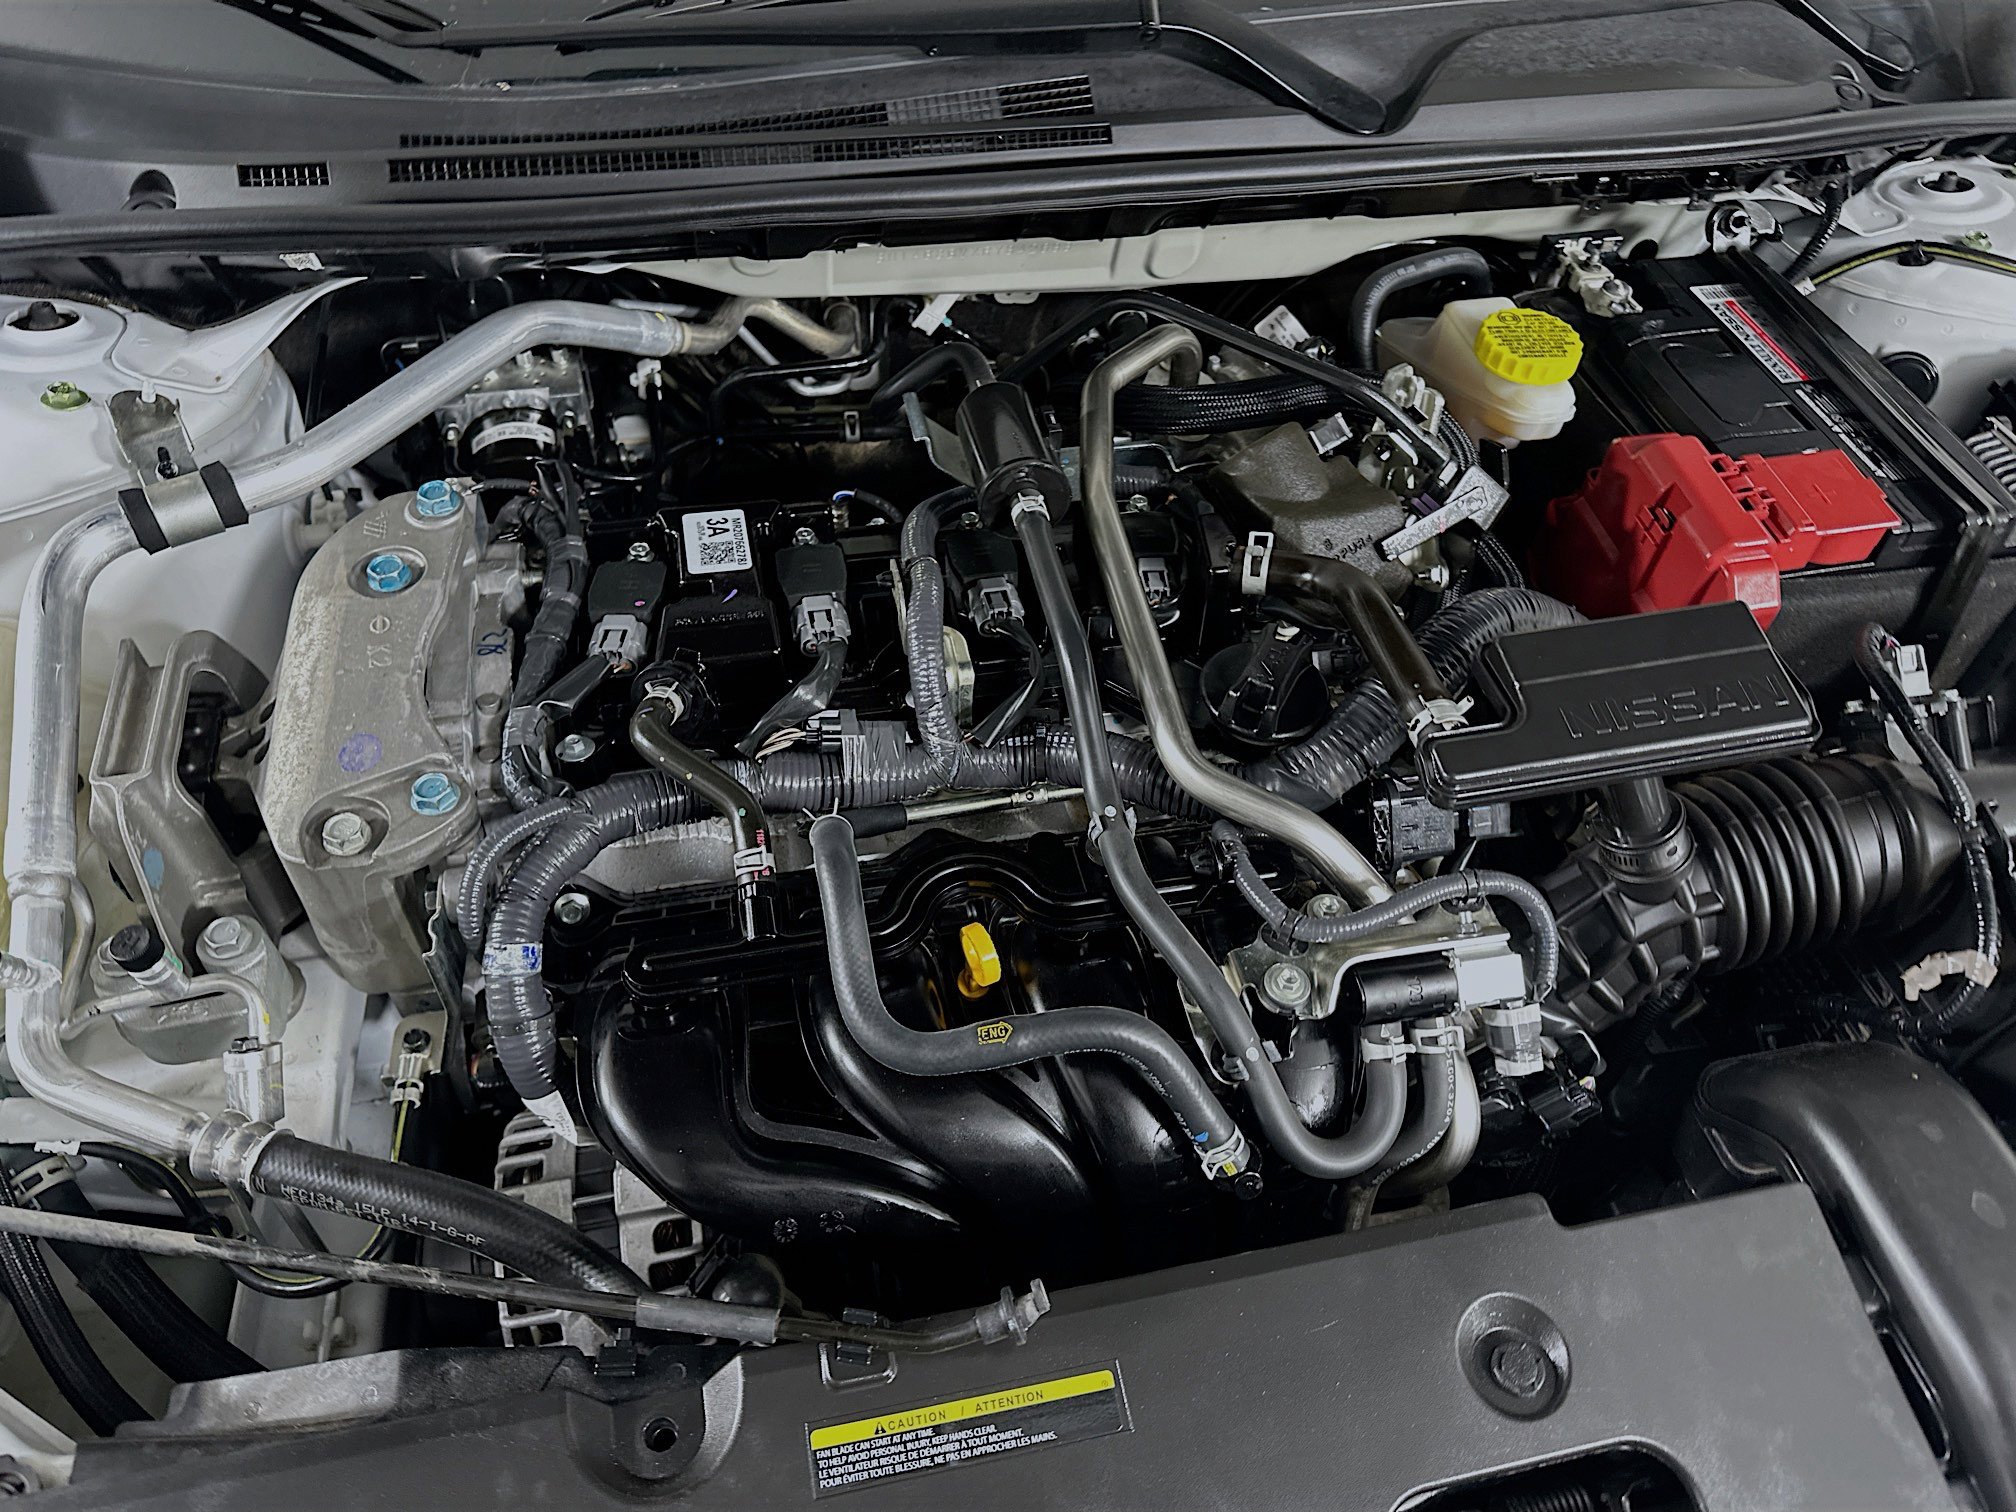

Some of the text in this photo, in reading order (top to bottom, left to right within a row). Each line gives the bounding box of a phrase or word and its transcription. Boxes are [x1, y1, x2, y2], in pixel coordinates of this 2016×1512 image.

[706, 517, 730, 538] 3A
[1558, 673, 1790, 739] NISSAN
[981, 1025, 1006, 1040] ENG
[887, 1410, 947, 1431] CAUTION
[975, 1389, 1044, 1413] ATTENTION
[816, 1449, 831, 1460] FAN
[831, 1445, 855, 1457] BLADE
[854, 1442, 870, 1453] CAN
[870, 1437, 893, 1449] START
[892, 1434, 901, 1443] AT
[818, 1459, 829, 1469] TO
[829, 1455, 847, 1467] HELP
[847, 1451, 870, 1464] AVOID
[870, 1445, 906, 1460] PERSONAL
[932, 1434, 949, 1445] KEEP
[949, 1429, 974, 1440] HANDS
[973, 1424, 997, 1436] CLEAR.
[818, 1469, 829, 1479] LE
[829, 1458, 880, 1477] VENTILATEUR
[880, 1451, 907, 1466] RISQUE
[908, 1450, 919, 1461] DE
[919, 1440, 961, 1457] DÉMARRER
[967, 1435, 989, 1447] TOUT
[988, 1427, 1025, 1443] MOMENT.
[820, 1430, 1058, 1489] POUR ÉVITER TOUTE BLESSURE, NE PAS EN APPROCHER LES MAINS.
